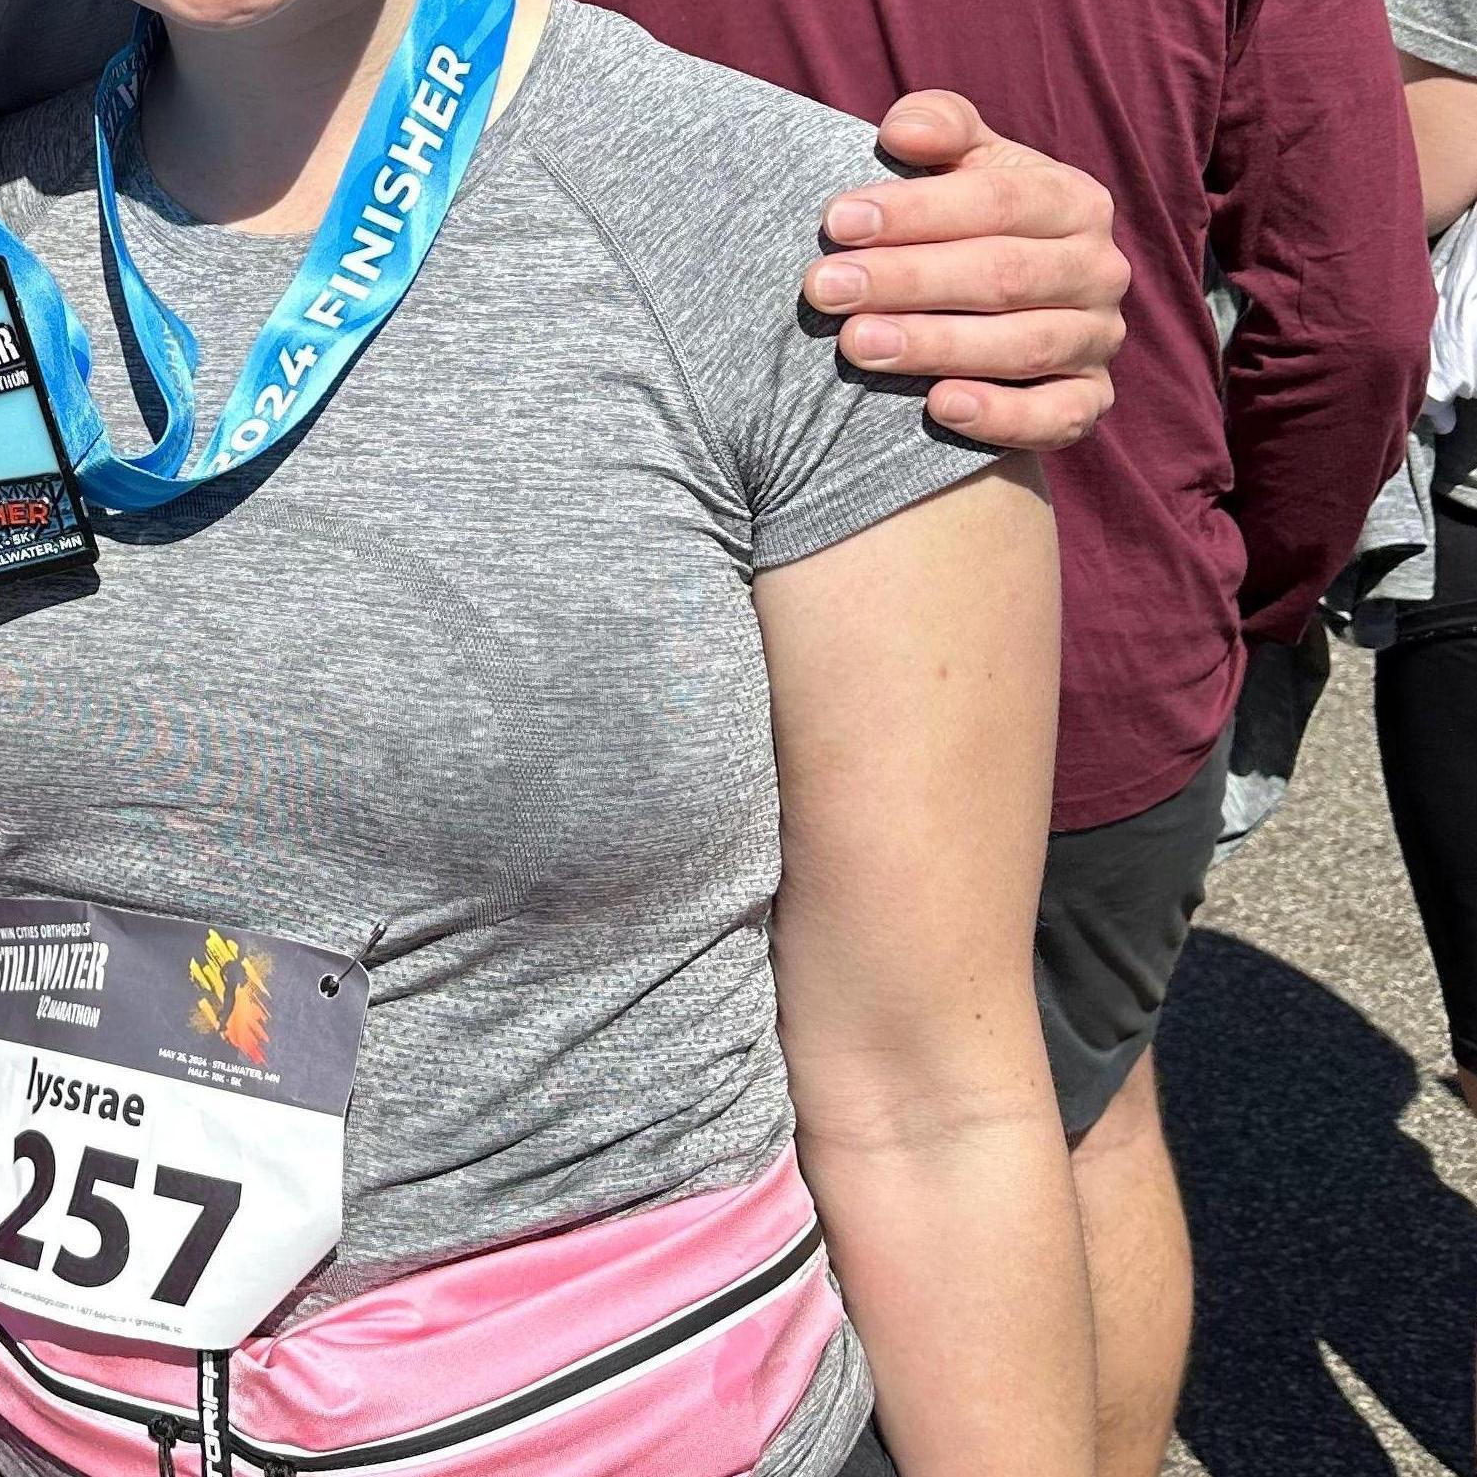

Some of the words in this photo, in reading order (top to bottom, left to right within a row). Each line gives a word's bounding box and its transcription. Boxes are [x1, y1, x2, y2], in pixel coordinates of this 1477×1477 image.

[304, 42, 472, 331] FINISHER
[12, 531, 31, 548] 5K
[60, 534, 84, 550] MN
[16, 925, 39, 939] CITIES
[40, 921, 92, 939] ORTHOPEDS
[47, 999, 101, 1028] MARATHON
[158, 1047, 176, 1061] MAY
[188, 1053, 208, 1067] 2024
[264, 1072, 281, 1084] MN
[26, 1056, 146, 1127] lyssrae
